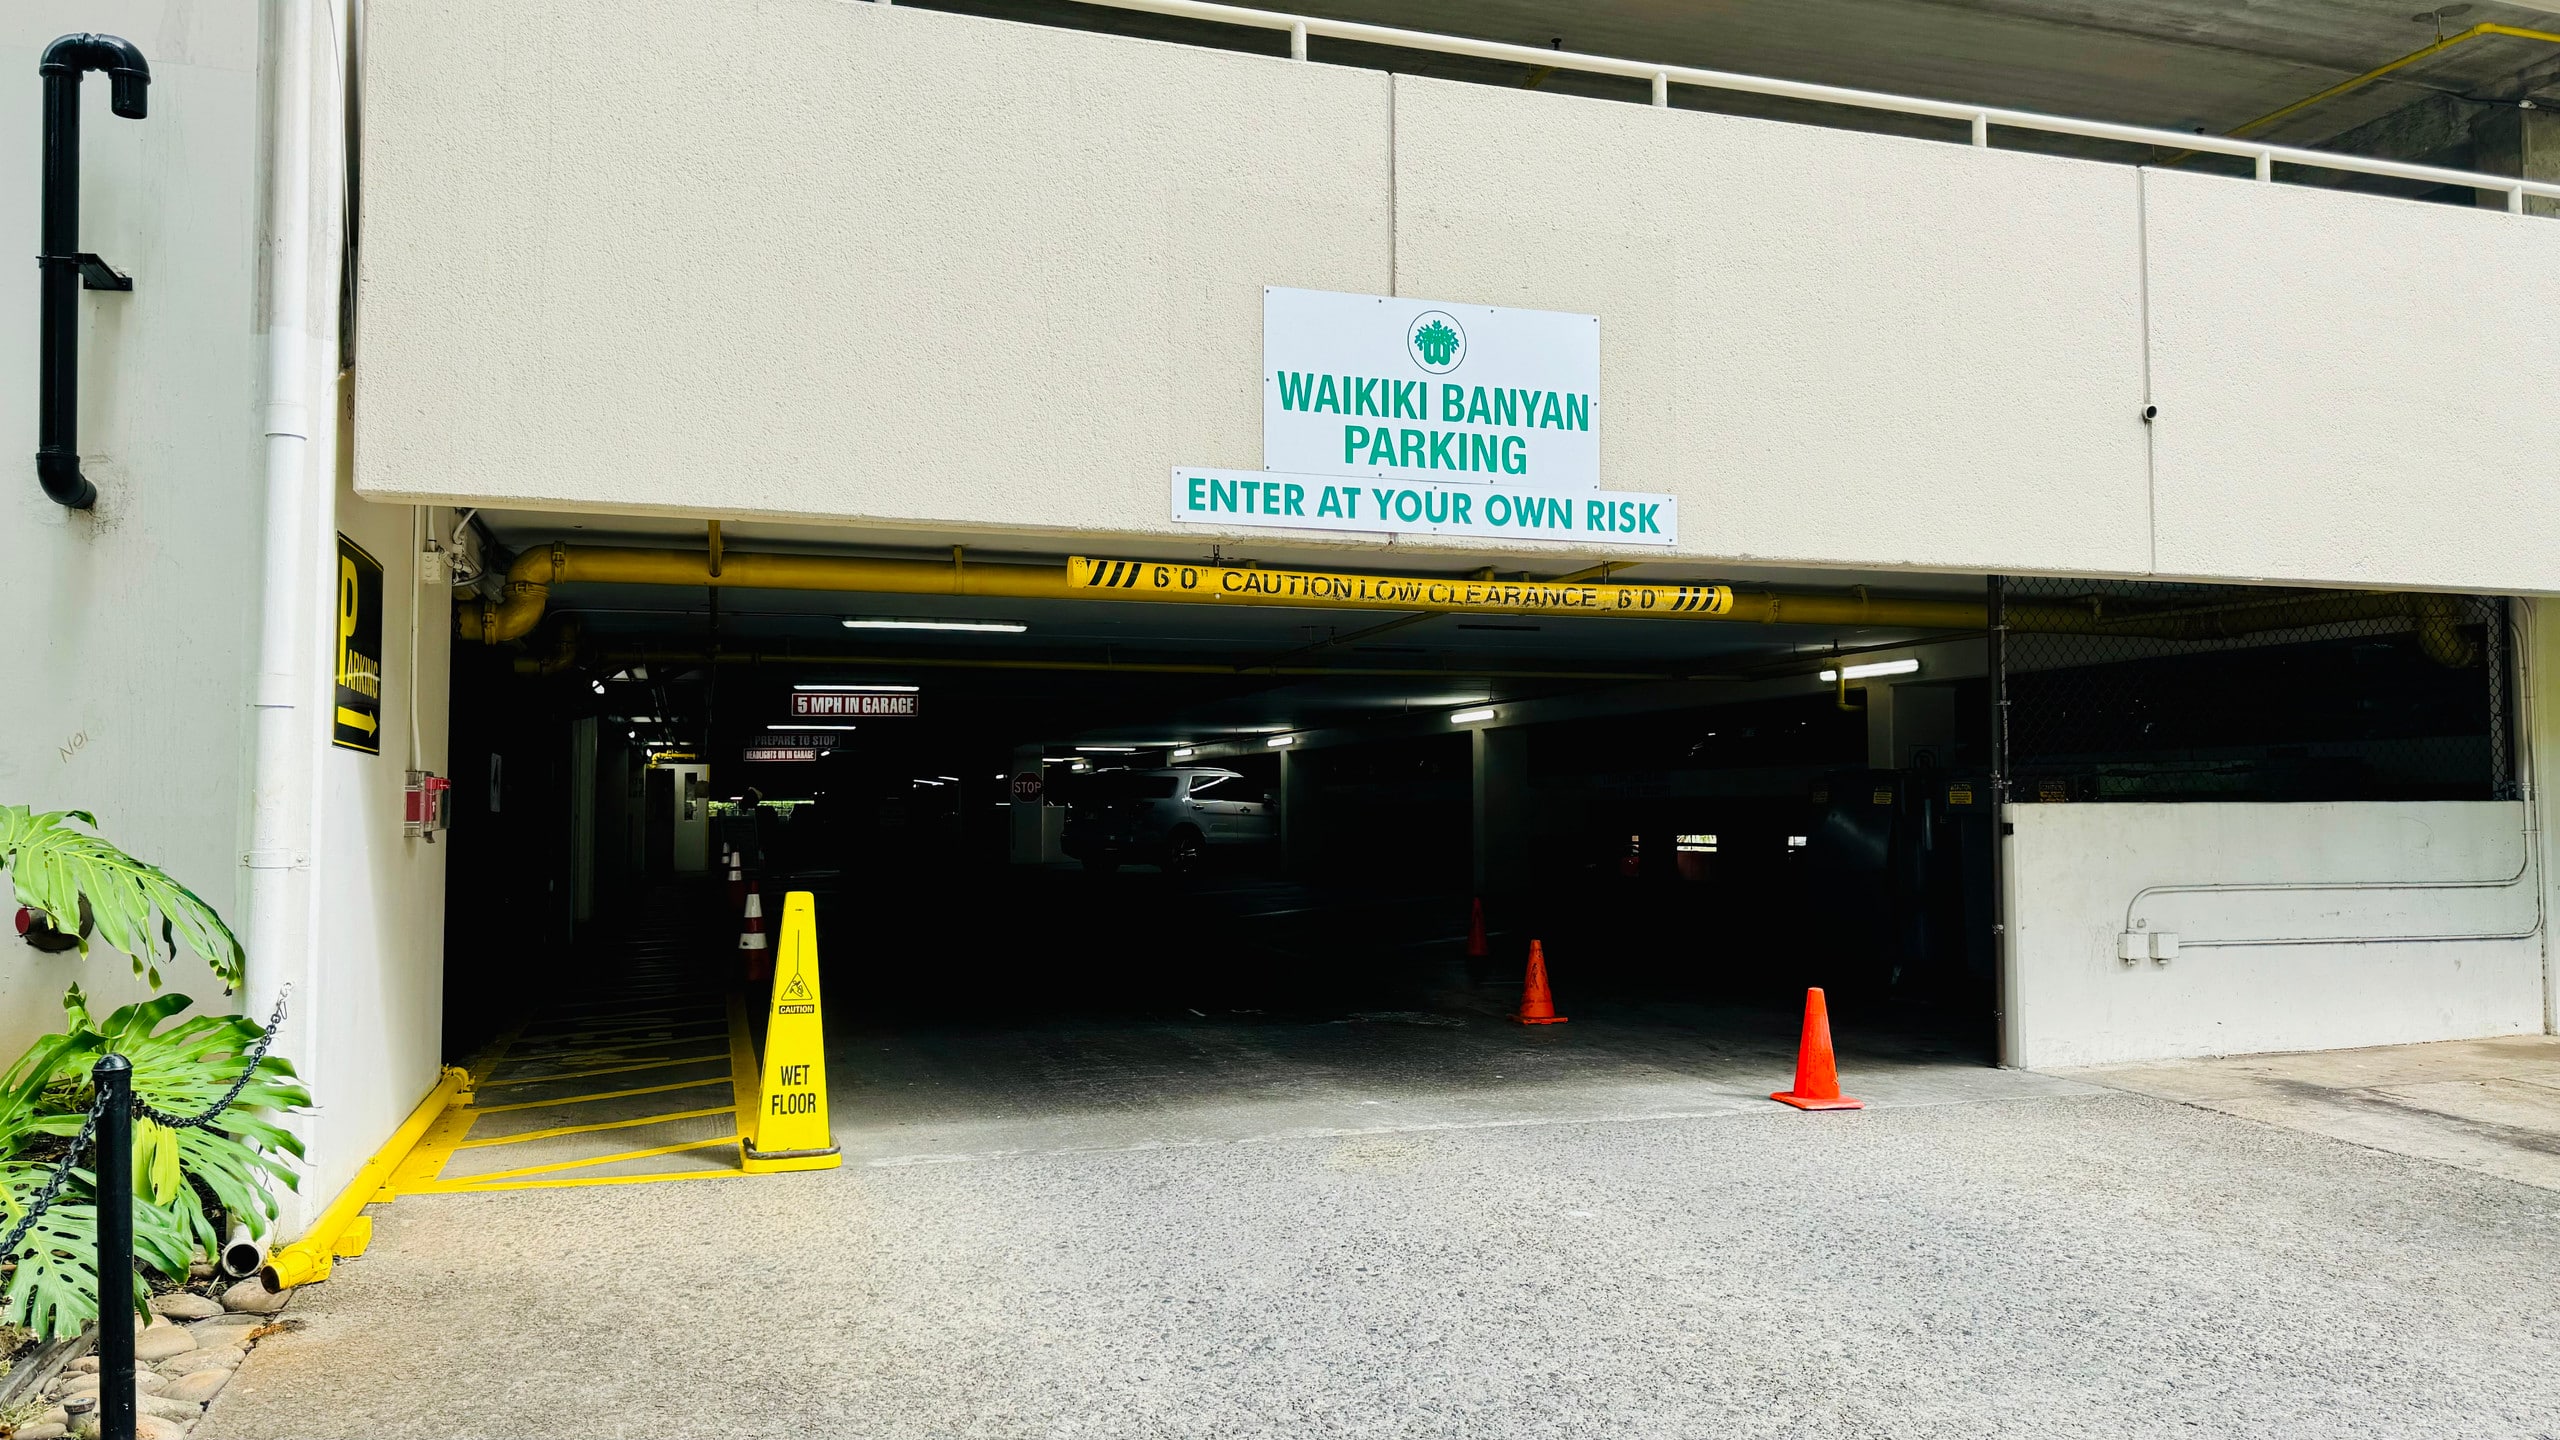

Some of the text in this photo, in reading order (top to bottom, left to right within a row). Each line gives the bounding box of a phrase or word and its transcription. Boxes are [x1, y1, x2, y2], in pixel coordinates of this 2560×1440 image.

[1278, 370, 1589, 433] WAIKIKI BANYAN
[1345, 425, 1527, 476] PARKING
[1188, 478, 1660, 534] ENTER AT YOUR OWN RISK
[1222, 571, 1352, 598] CAUTION
[1359, 579, 1422, 602] LOW
[1428, 583, 1597, 608] CLEARANCE
[797, 696, 914, 714] 5 MPH IN GARAGE
[755, 735, 836, 746] PREPARE TO STOP
[793, 750, 815, 759] GARAGE
[1014, 781, 1042, 793] STOP
[780, 1005, 814, 1013] CAUTION
[781, 1065, 810, 1086] WET
[771, 1093, 816, 1116] FLOOR
